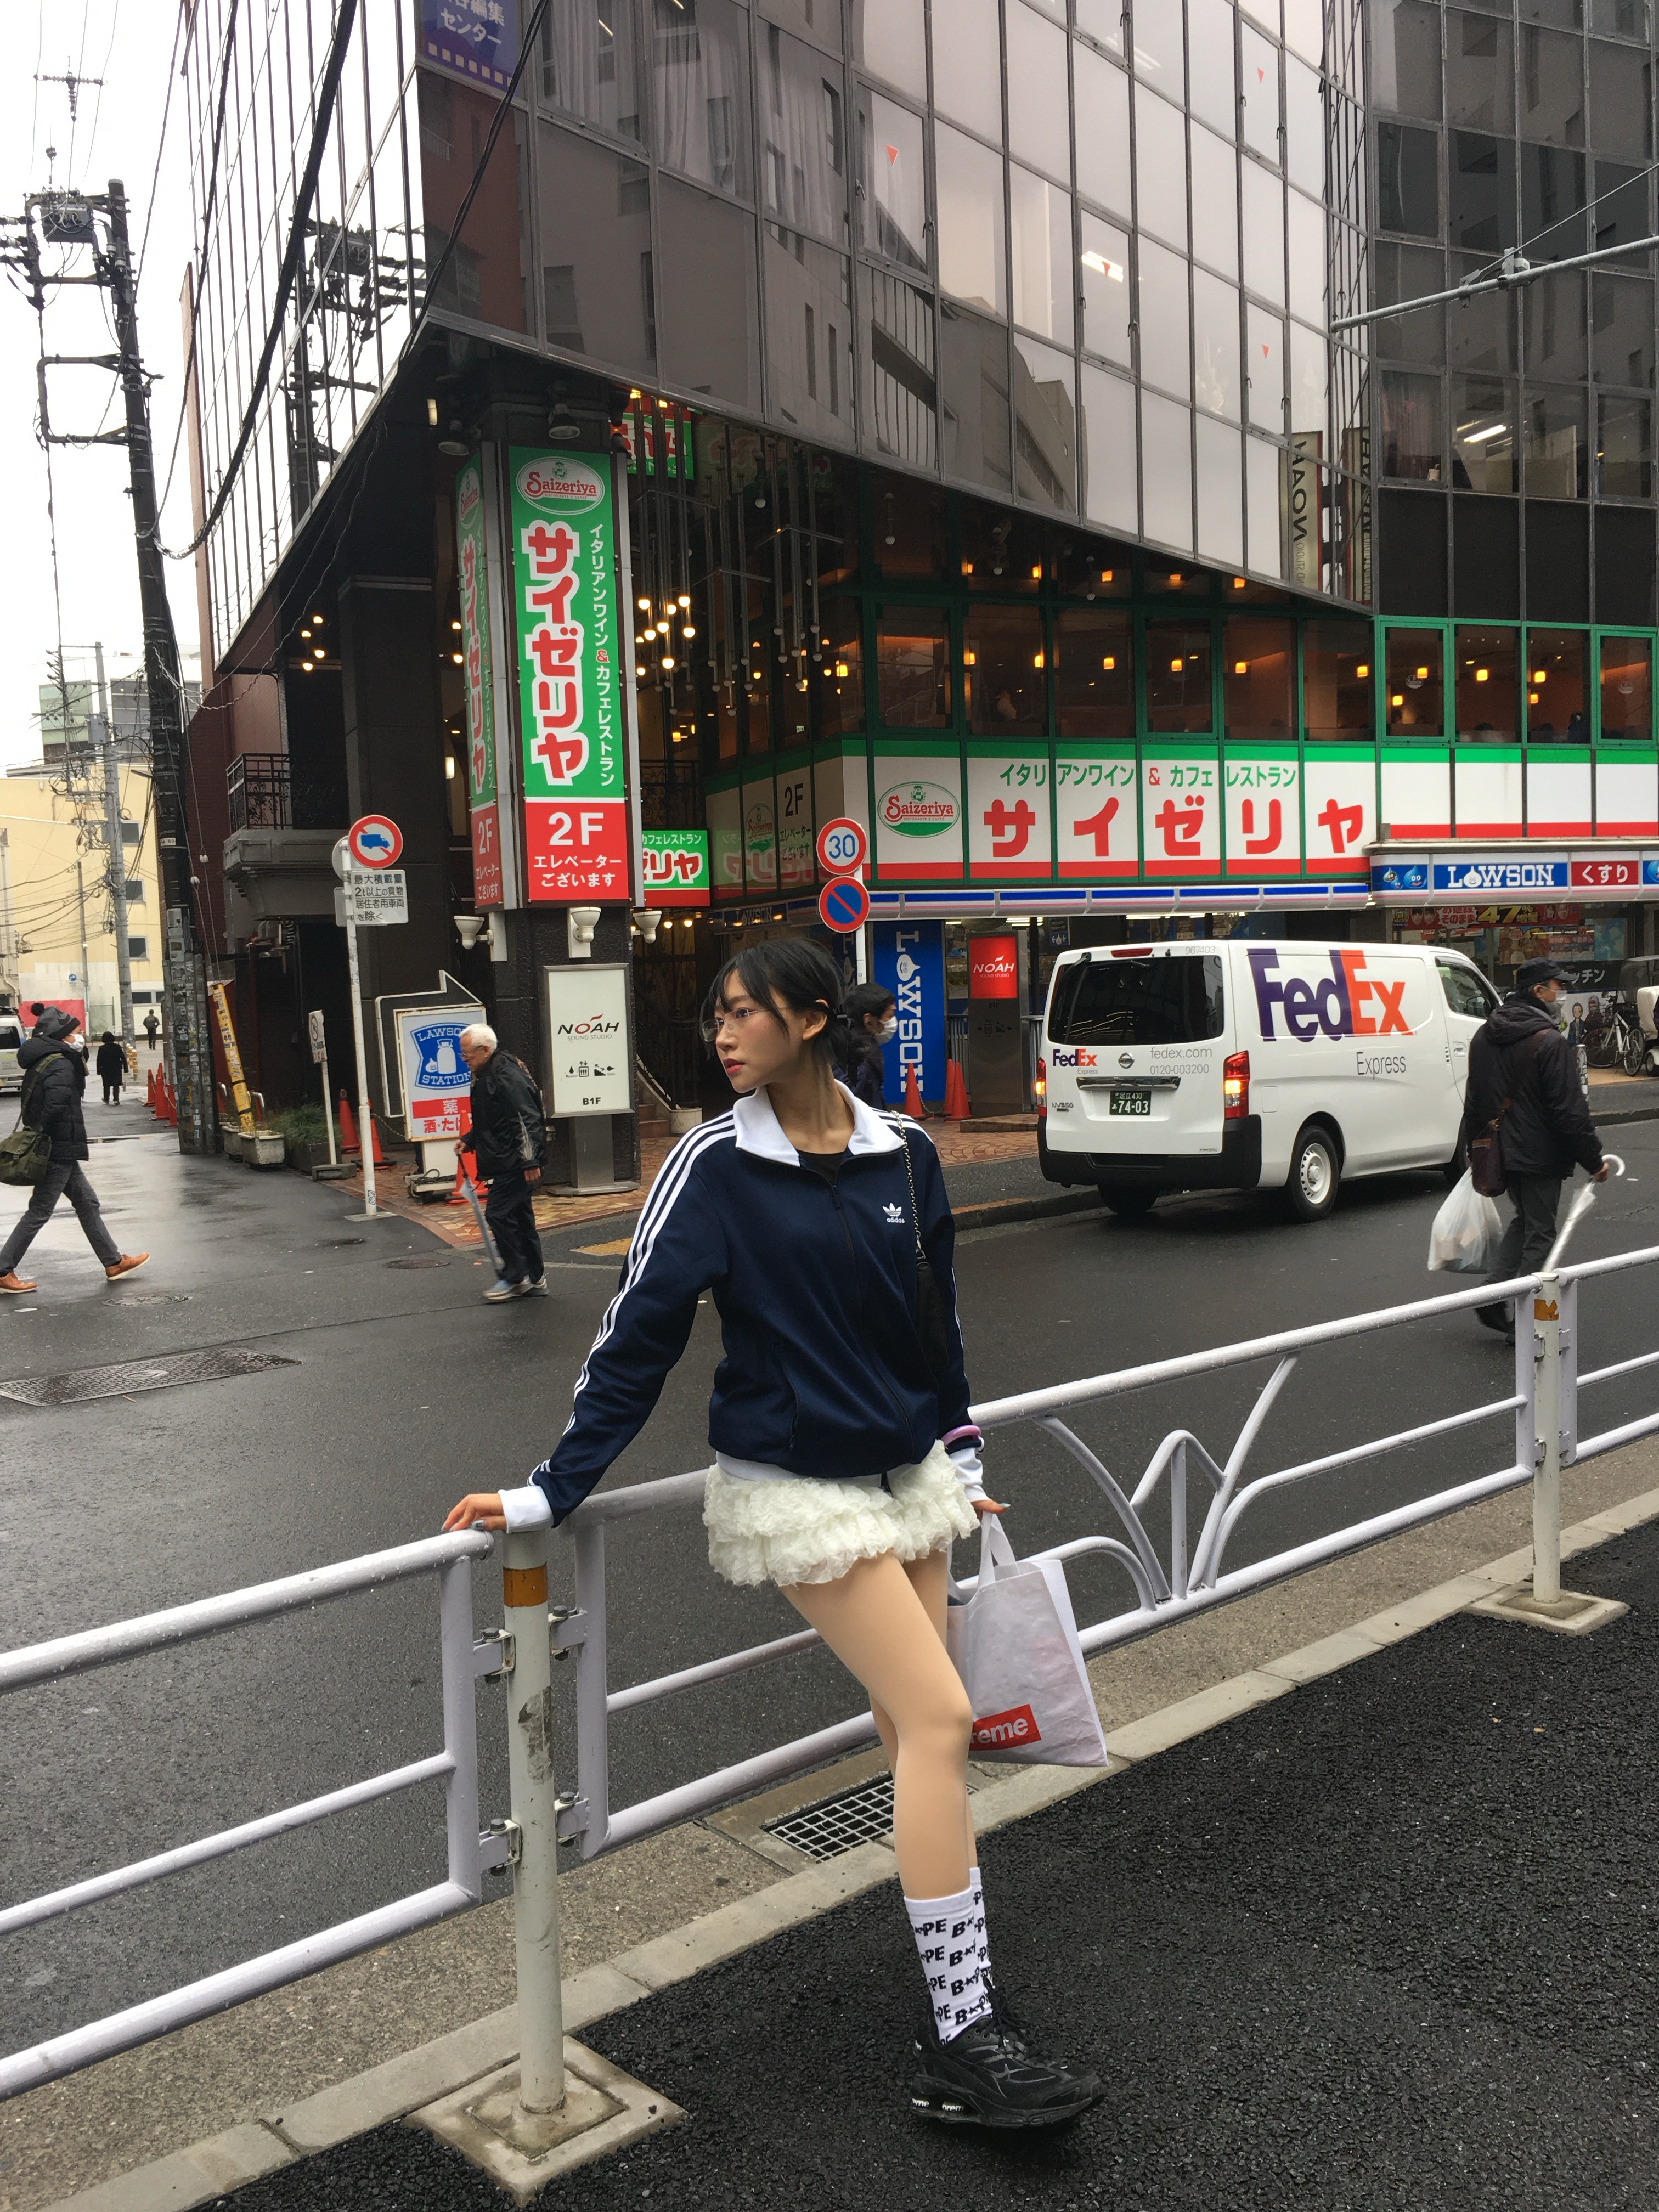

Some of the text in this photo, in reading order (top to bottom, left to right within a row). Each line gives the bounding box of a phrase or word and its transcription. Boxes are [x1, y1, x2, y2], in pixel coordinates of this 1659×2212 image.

[441, 8, 502, 44] センター
[526, 471, 597, 495] Saizeriya
[524, 522, 588, 785] サイゼリヤ
[589, 524, 614, 787] イタリアンワイン & カフェレストラン
[462, 534, 486, 793] サイゼリヤ
[1000, 763, 1135, 787] イタリアンワイン
[1148, 766, 1161, 786] &
[784, 783, 804, 817] 2F
[884, 795, 954, 819] Saizeriya
[548, 812, 604, 845] 2F
[779, 824, 812, 843] エレベーター
[983, 795, 1363, 858] サイゼリヤ
[478, 817, 493, 855] 2F
[828, 834, 856, 859] 30
[534, 854, 622, 868] エレベーター
[354, 873, 403, 884] 最大積載量
[475, 863, 499, 880] エレベーター
[541, 872, 616, 888] ございます
[1582, 864, 1629, 884] くすり
[355, 886, 404, 897] 2t以上の貨物
[478, 882, 499, 900] ございます
[356, 898, 405, 909] 居住者用車両
[357, 911, 383, 921] を除く
[1441, 915, 1475, 924] そのまま
[1184, 946, 1216, 955] 967403
[973, 962, 1015, 973] NOAH
[1246, 948, 1414, 1042] FedEx
[417, 1027, 462, 1042] LAWSO
[557, 1022, 620, 1035] NOAH
[1053, 1048, 1098, 1067] FedEx
[1150, 1047, 1212, 1059] fedex.com
[1150, 1064, 1210, 1075] 0120-003200
[1356, 1051, 1407, 1080] Express
[422, 1071, 472, 1085] STATION
[443, 1099, 459, 1114] 薬
[583, 1097, 601, 1105] B1F
[1118, 1100, 1149, 1113] 74-03
[969, 1718, 1028, 1745] reme
